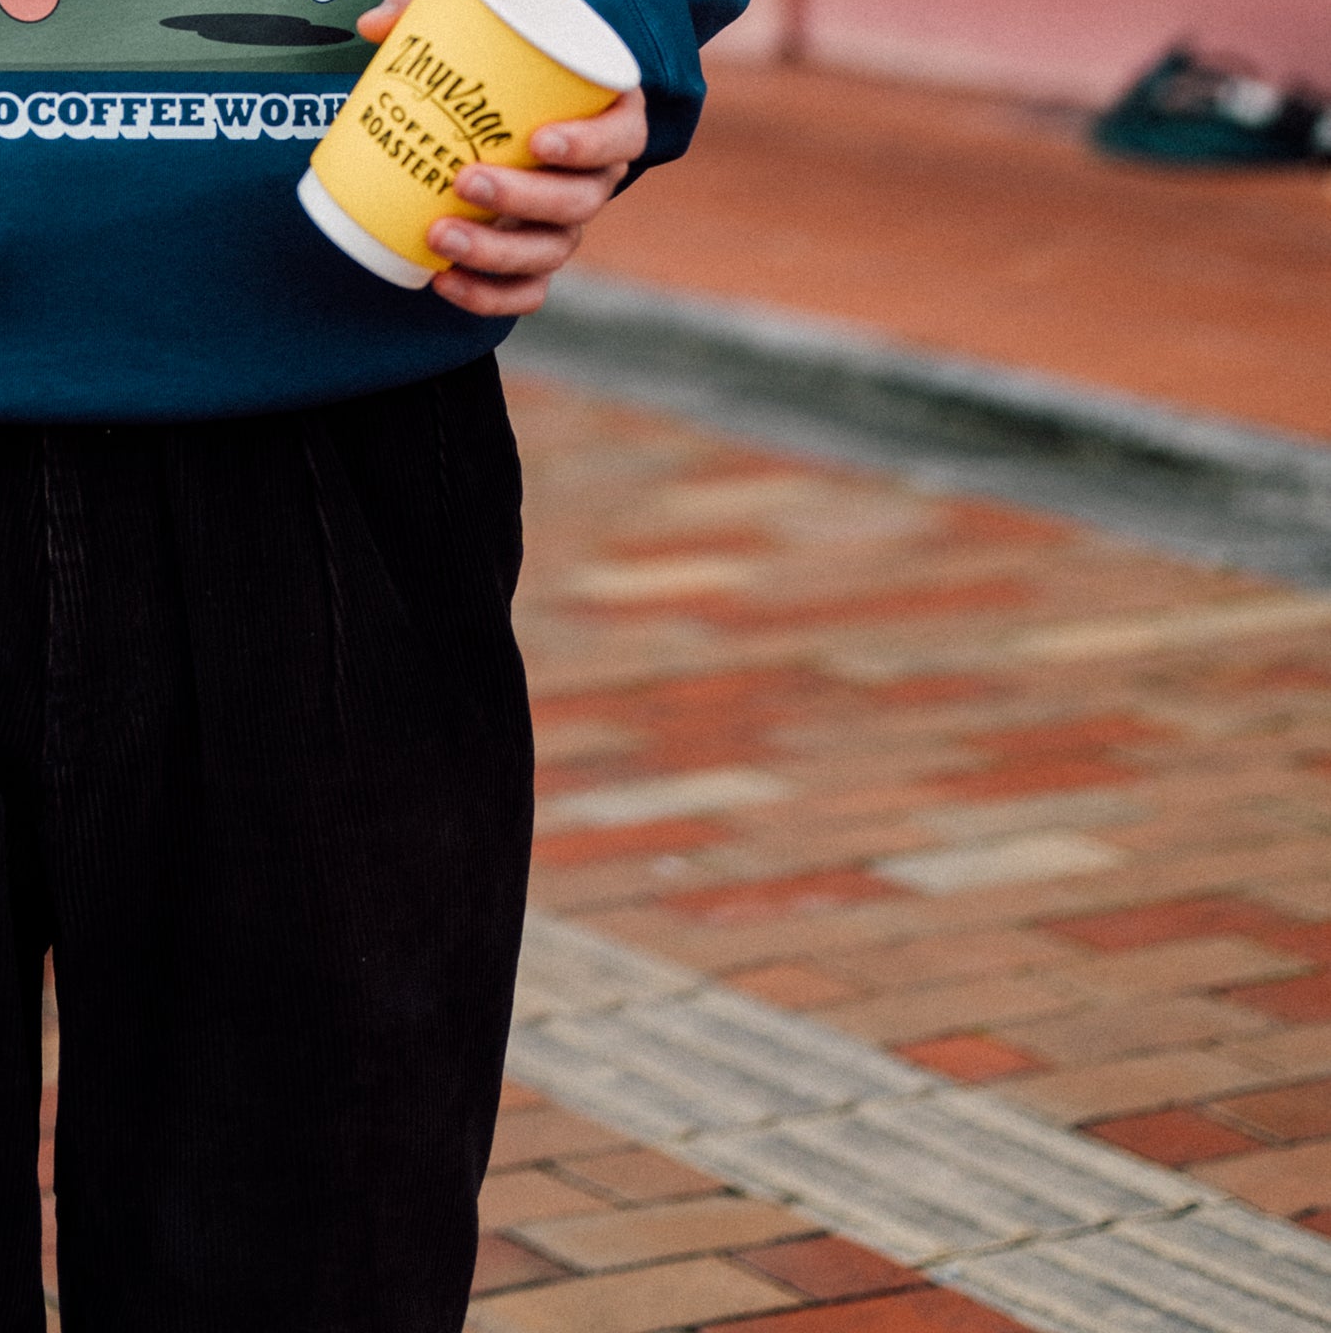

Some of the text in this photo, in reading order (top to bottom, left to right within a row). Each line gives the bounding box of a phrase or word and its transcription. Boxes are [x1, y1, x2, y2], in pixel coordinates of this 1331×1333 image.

[25, 94, 210, 134] COFFEE
[213, 95, 349, 134] WORK
[360, 104, 454, 195] ROASTERY
[379, 91, 466, 172] COFFEE
